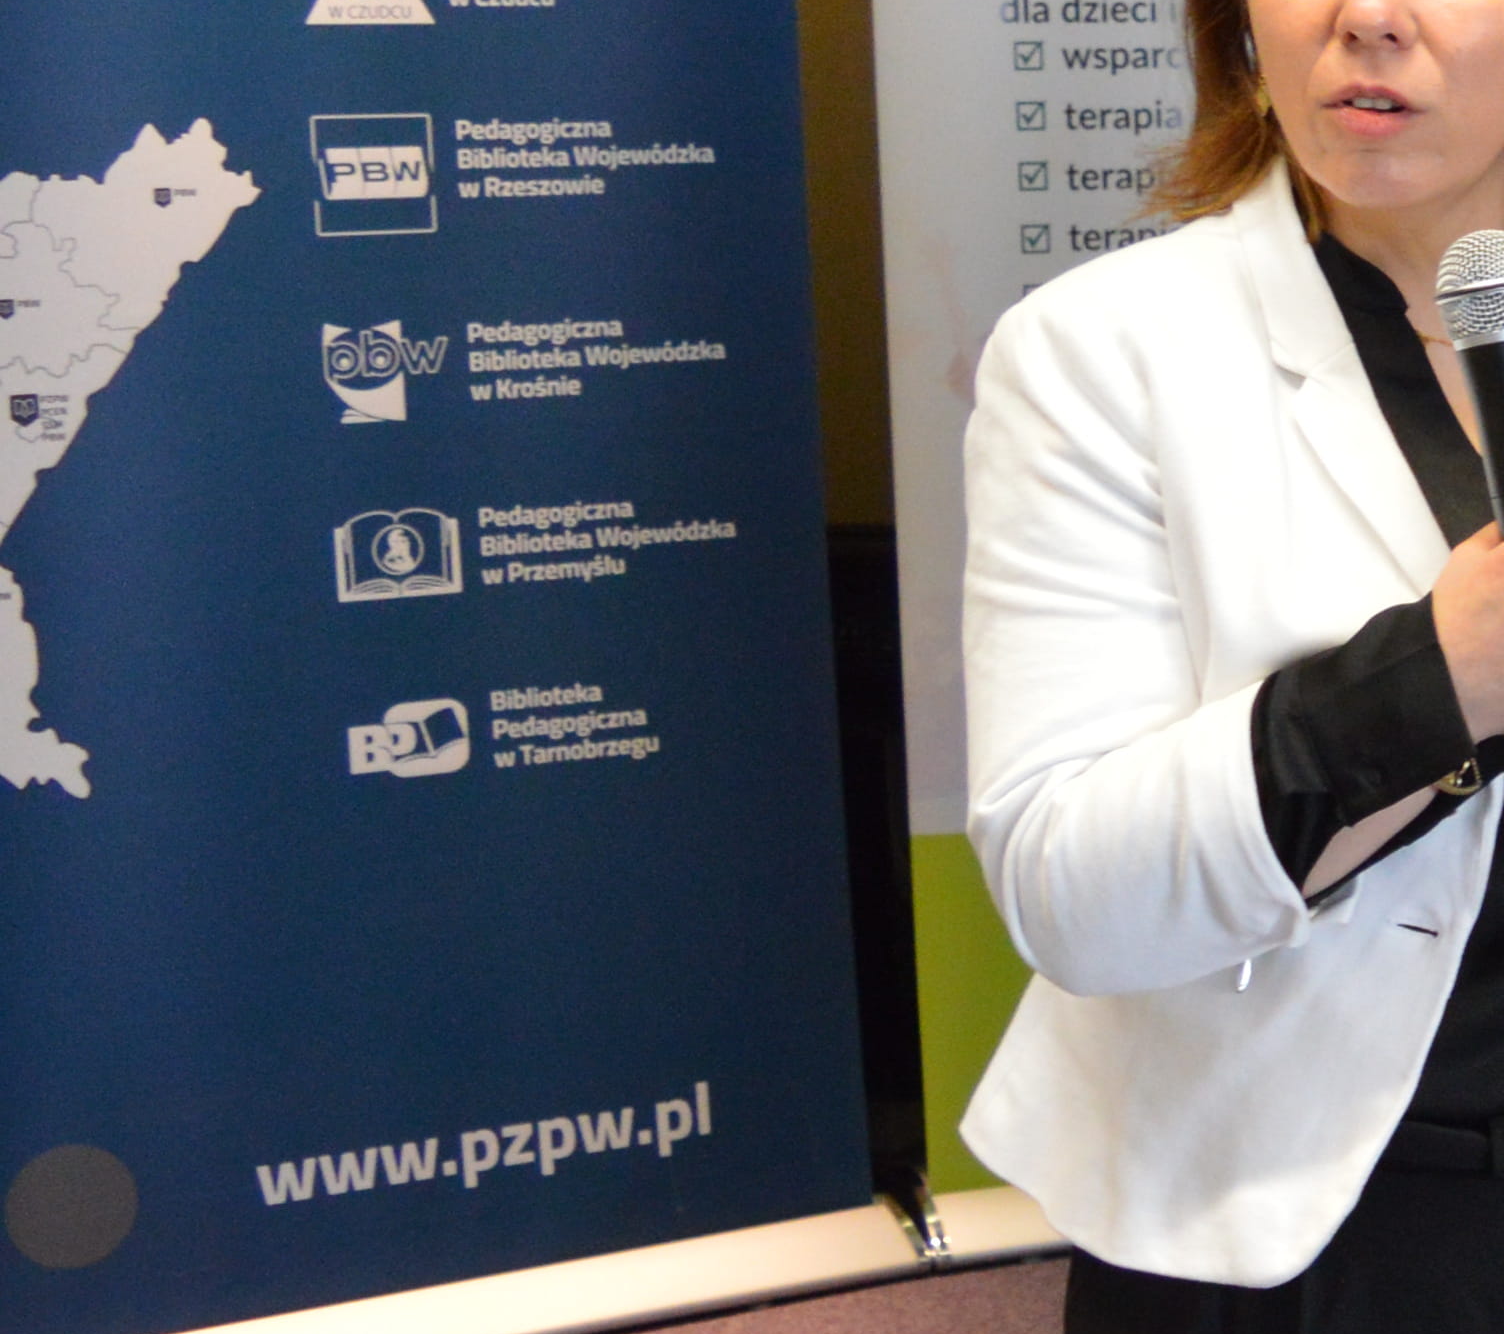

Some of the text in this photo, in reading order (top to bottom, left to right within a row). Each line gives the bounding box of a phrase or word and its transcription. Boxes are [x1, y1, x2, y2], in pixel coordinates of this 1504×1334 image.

[328, 4, 413, 20] W CZUDCU
[455, 117, 612, 143] Pedagogiczna
[1064, 101, 1183, 137] terapia
[457, 142, 716, 170] Biblioteka Wojewódzka
[330, 159, 423, 184] PBW
[1066, 163, 1157, 195] terap
[459, 174, 605, 199] w Rzeszowie
[467, 317, 624, 346] Pedagogiczna
[468, 340, 726, 373] Biblioteka Wojewódzka
[471, 375, 582, 402] w Krośnie
[478, 500, 634, 528] Pedagogiczna
[480, 519, 737, 557] Biblioteka Wojewódzka
[482, 555, 626, 585] w Przemyślu
[490, 683, 603, 711] Biblioteka
[492, 706, 648, 740] Pedagogiczna
[495, 733, 660, 768] w Tarnobrzegu
[256, 1081, 713, 1207] www.pzpw.pl
